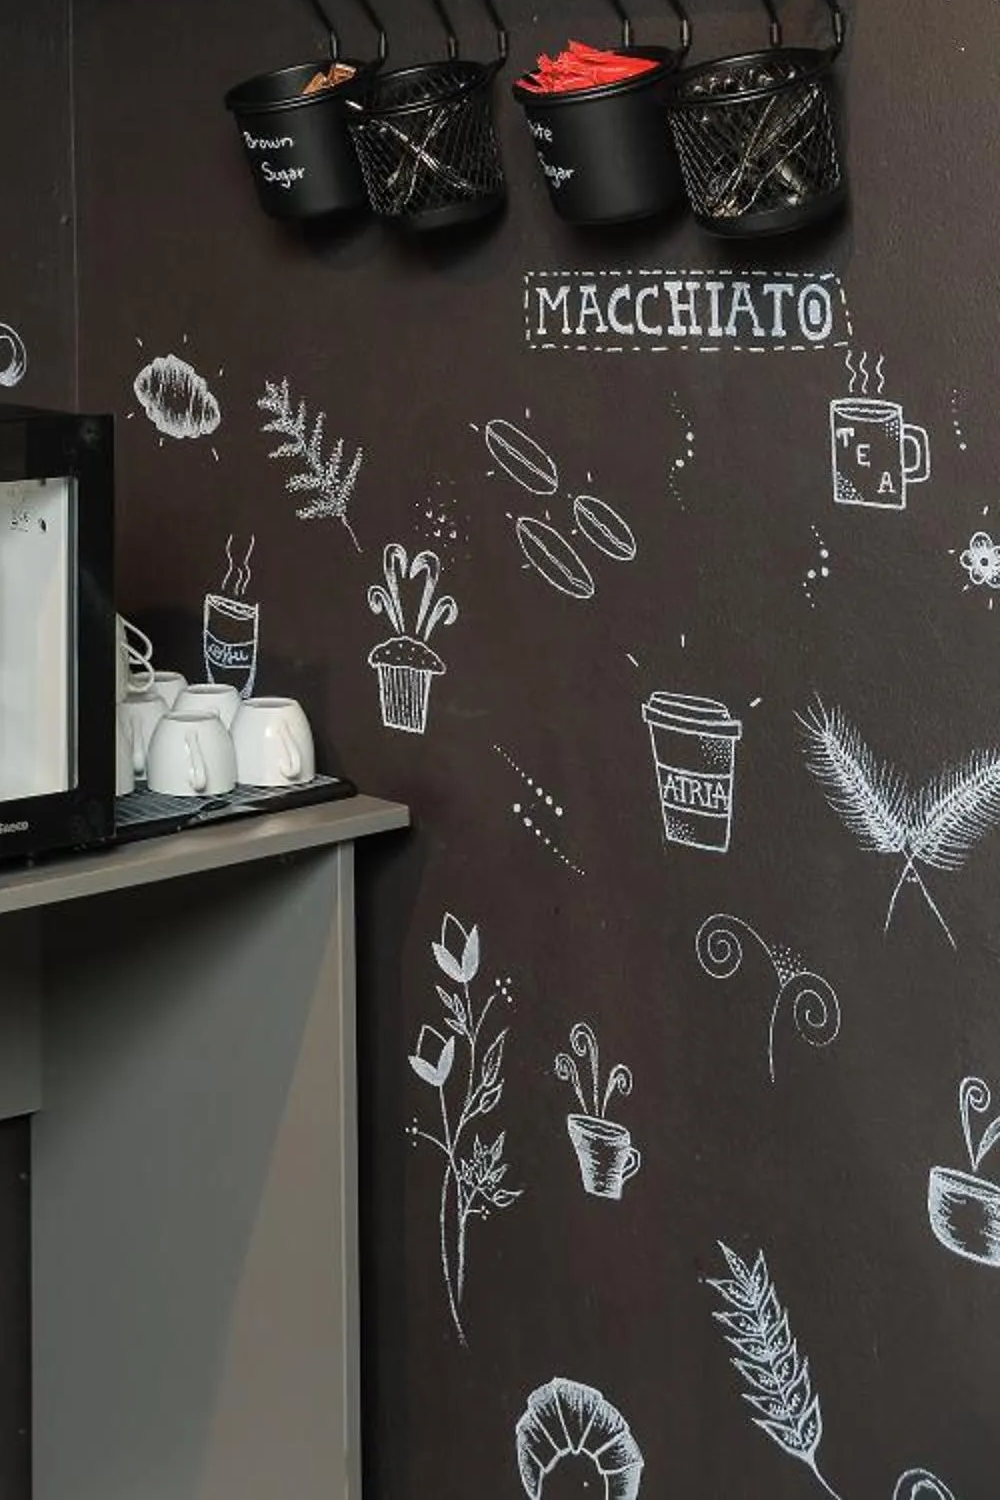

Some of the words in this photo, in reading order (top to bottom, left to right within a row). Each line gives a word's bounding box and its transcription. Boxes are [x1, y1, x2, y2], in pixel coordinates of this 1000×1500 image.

[261, 161, 306, 189] Sugar
[535, 280, 833, 341] MACCHIATO
[835, 427, 897, 495] TEA
[662, 773, 730, 811] ATRIA
